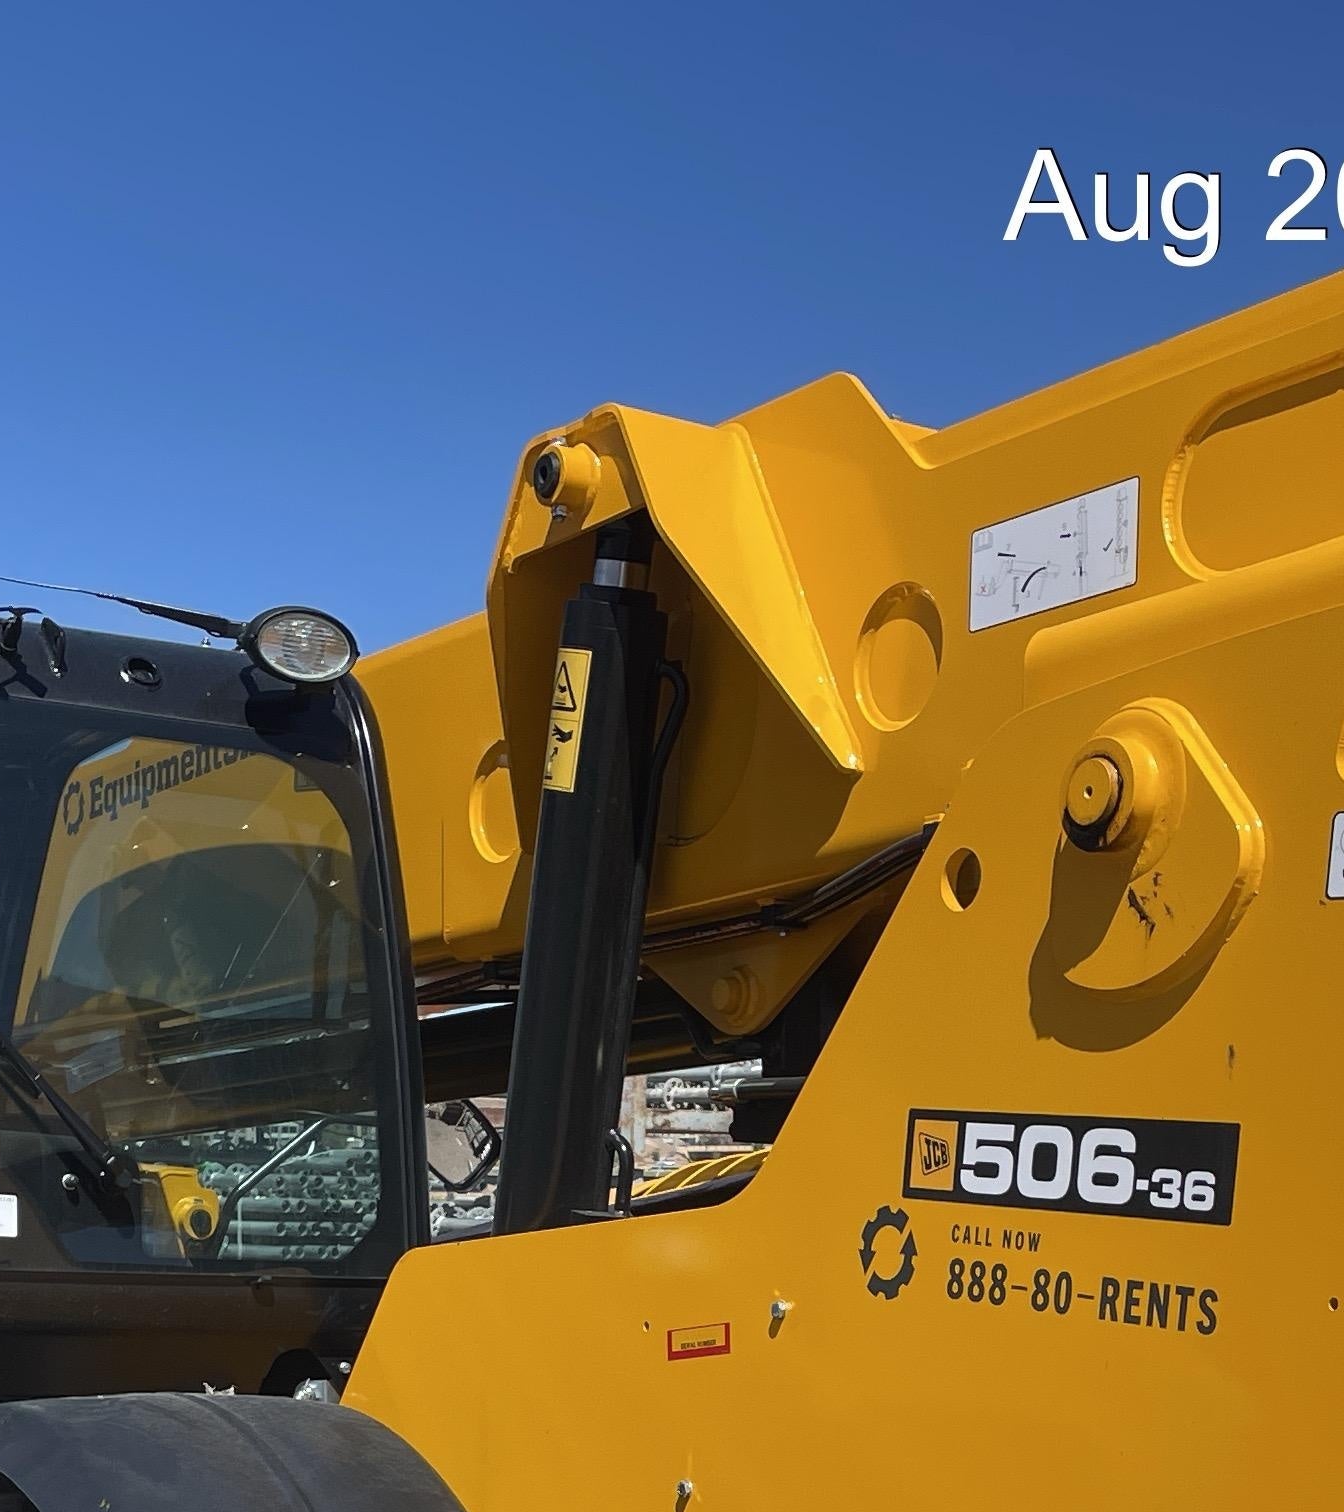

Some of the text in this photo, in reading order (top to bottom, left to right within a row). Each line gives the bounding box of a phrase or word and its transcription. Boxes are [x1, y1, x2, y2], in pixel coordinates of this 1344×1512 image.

[923, 1121, 1216, 1212] JCB 506-36
[950, 1223, 1042, 1253] CALL NOW
[946, 1257, 1219, 1336] 888-80-RENTS
